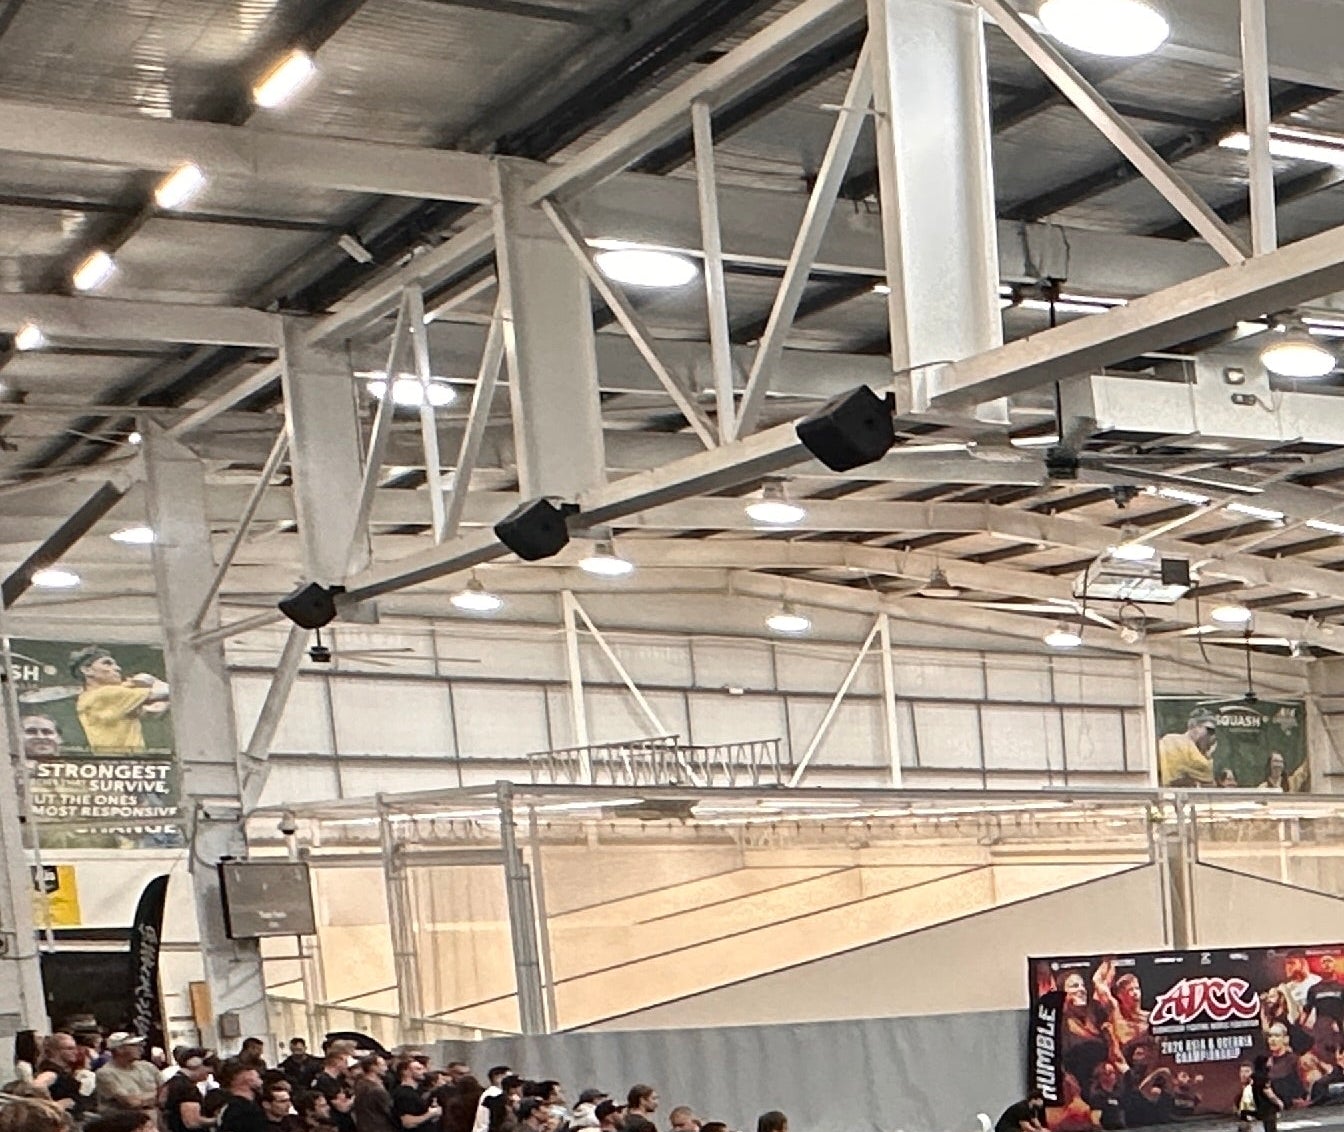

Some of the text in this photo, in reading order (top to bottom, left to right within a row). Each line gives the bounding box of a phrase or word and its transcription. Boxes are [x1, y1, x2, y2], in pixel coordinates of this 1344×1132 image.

[37, 763, 171, 779] STRONGEST
[89, 780, 170, 794] SURVIVE,
[61, 794, 92, 805] THE
[94, 795, 137, 805] ONES
[31, 805, 77, 816] MOST
[1149, 978, 1260, 1025] ADCC
[1036, 1004, 1058, 1100] HUMBLE
